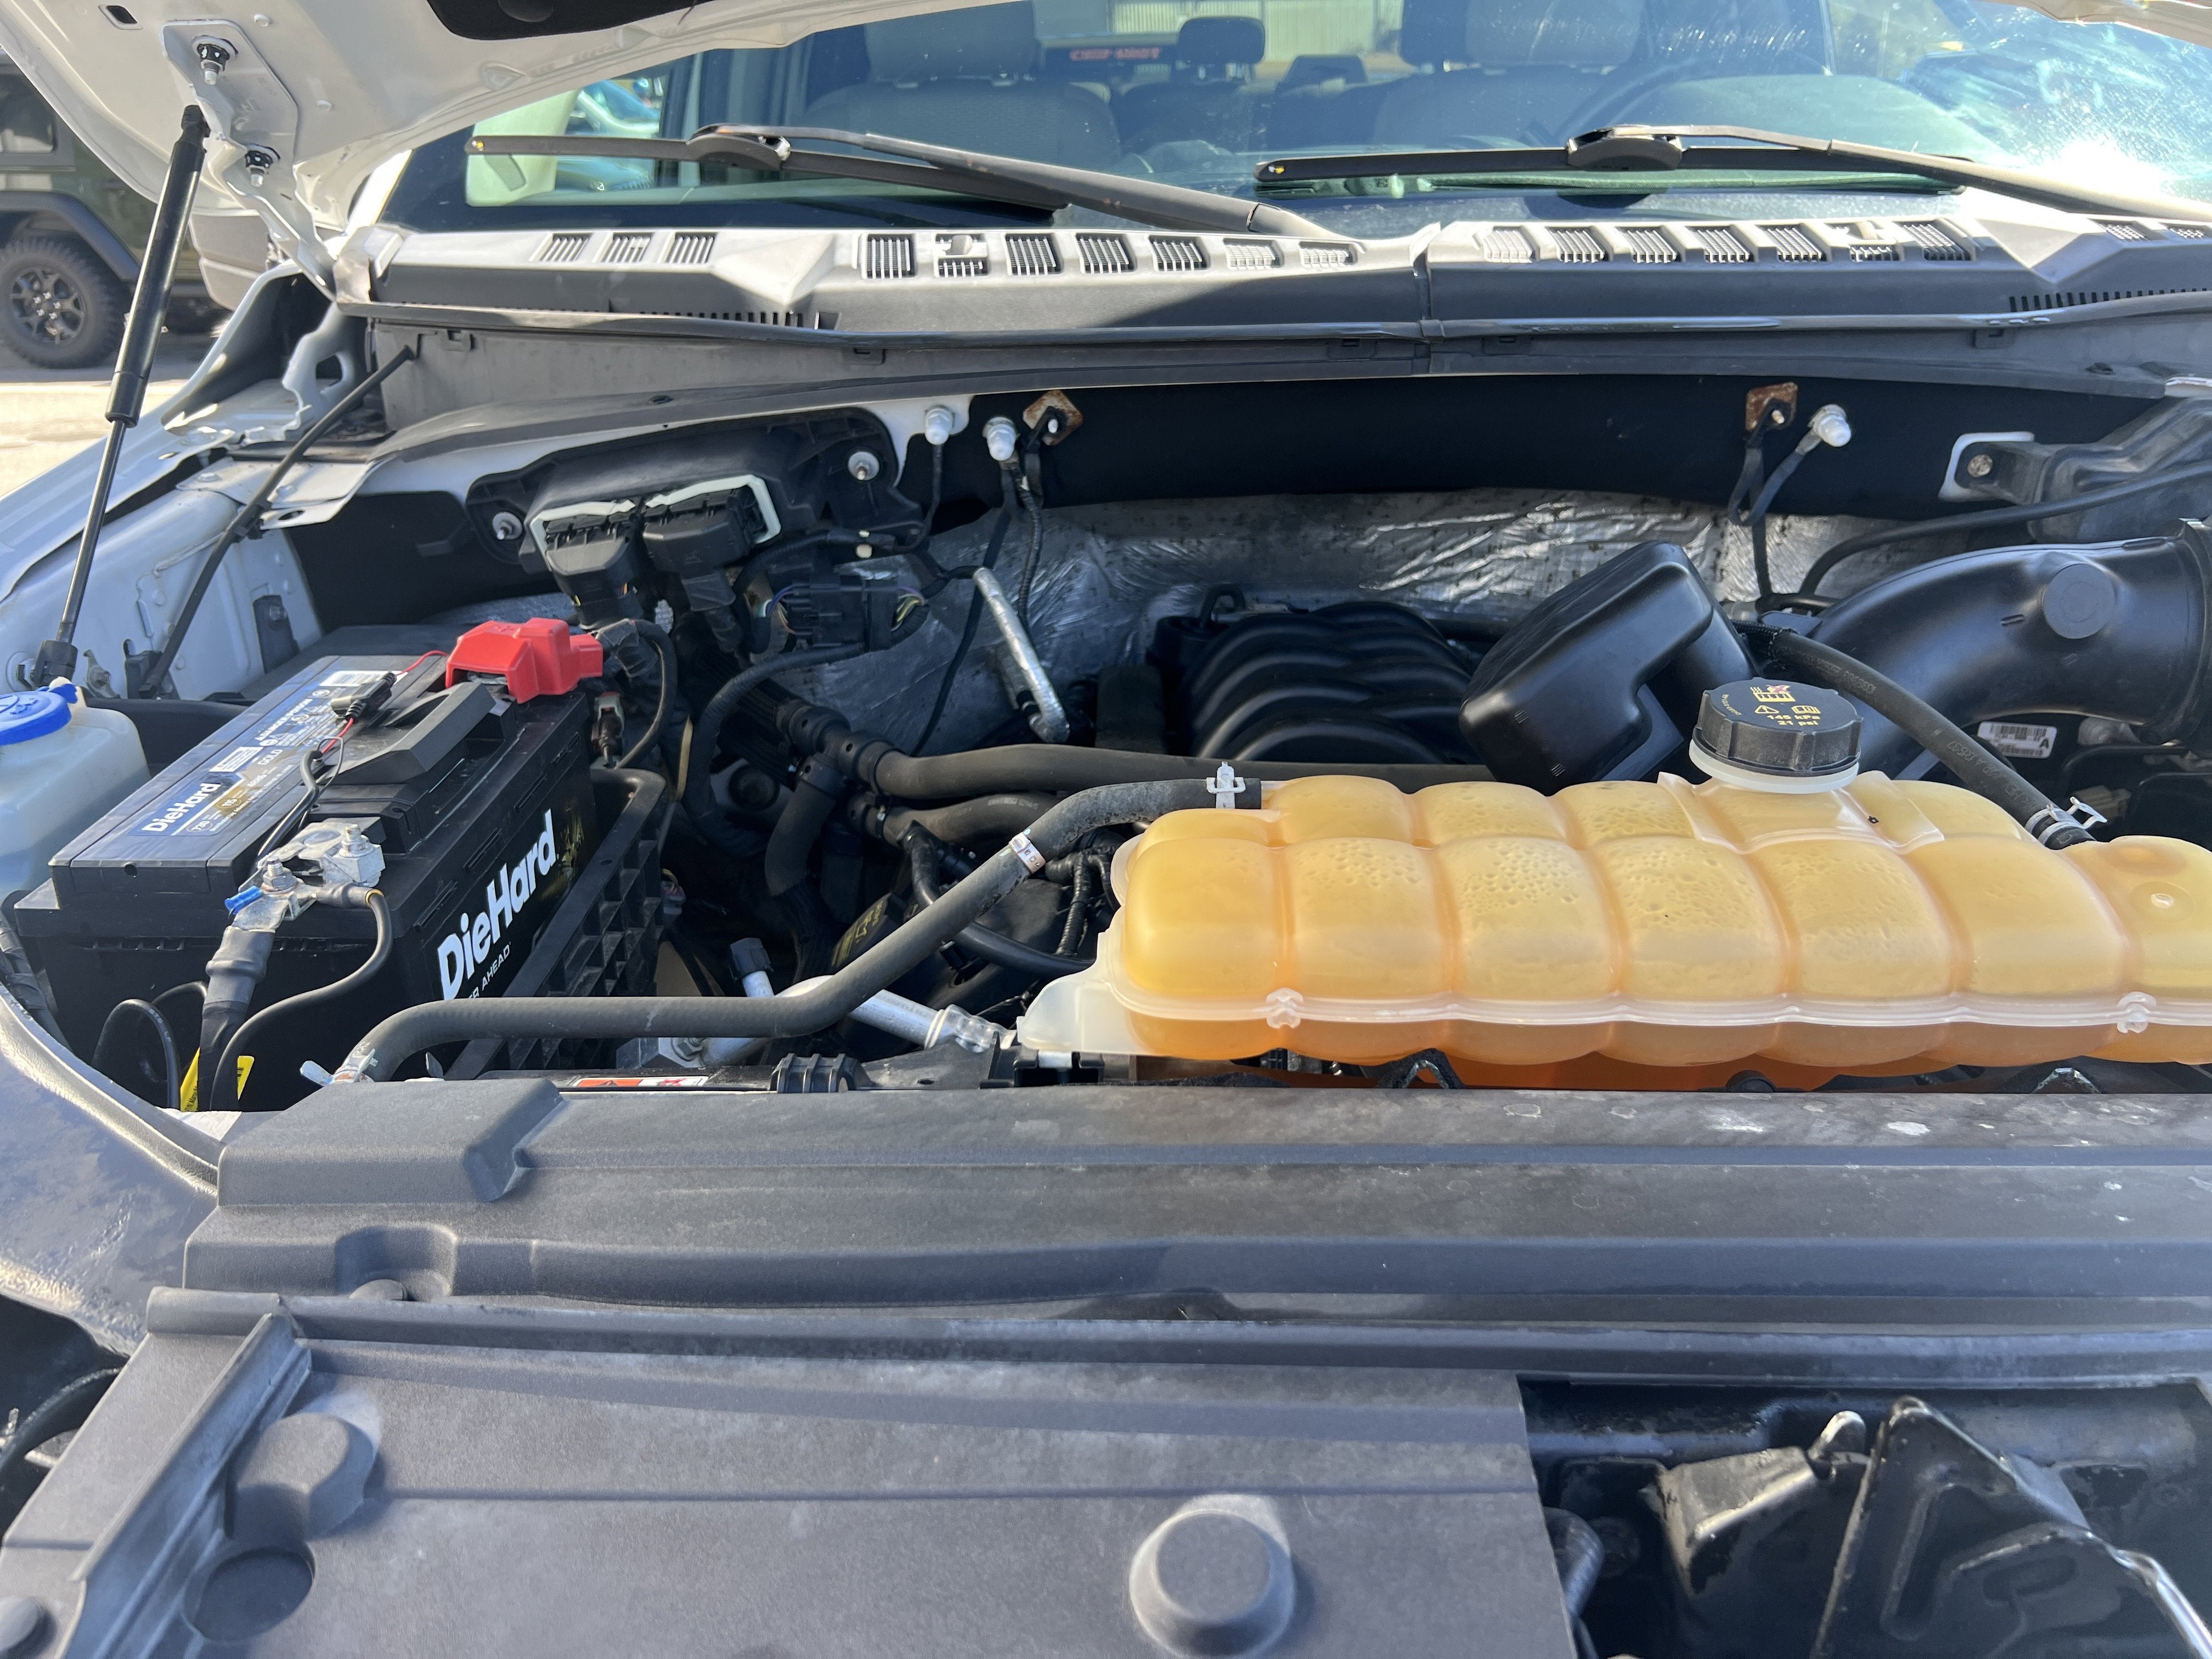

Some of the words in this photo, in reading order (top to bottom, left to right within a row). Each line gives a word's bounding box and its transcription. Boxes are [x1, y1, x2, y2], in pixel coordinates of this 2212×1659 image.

[257, 749, 284, 765] GOLD
[142, 783, 221, 832] DieHard
[438, 808, 556, 1001] DieHard
[482, 944, 510, 991] AHEAD
